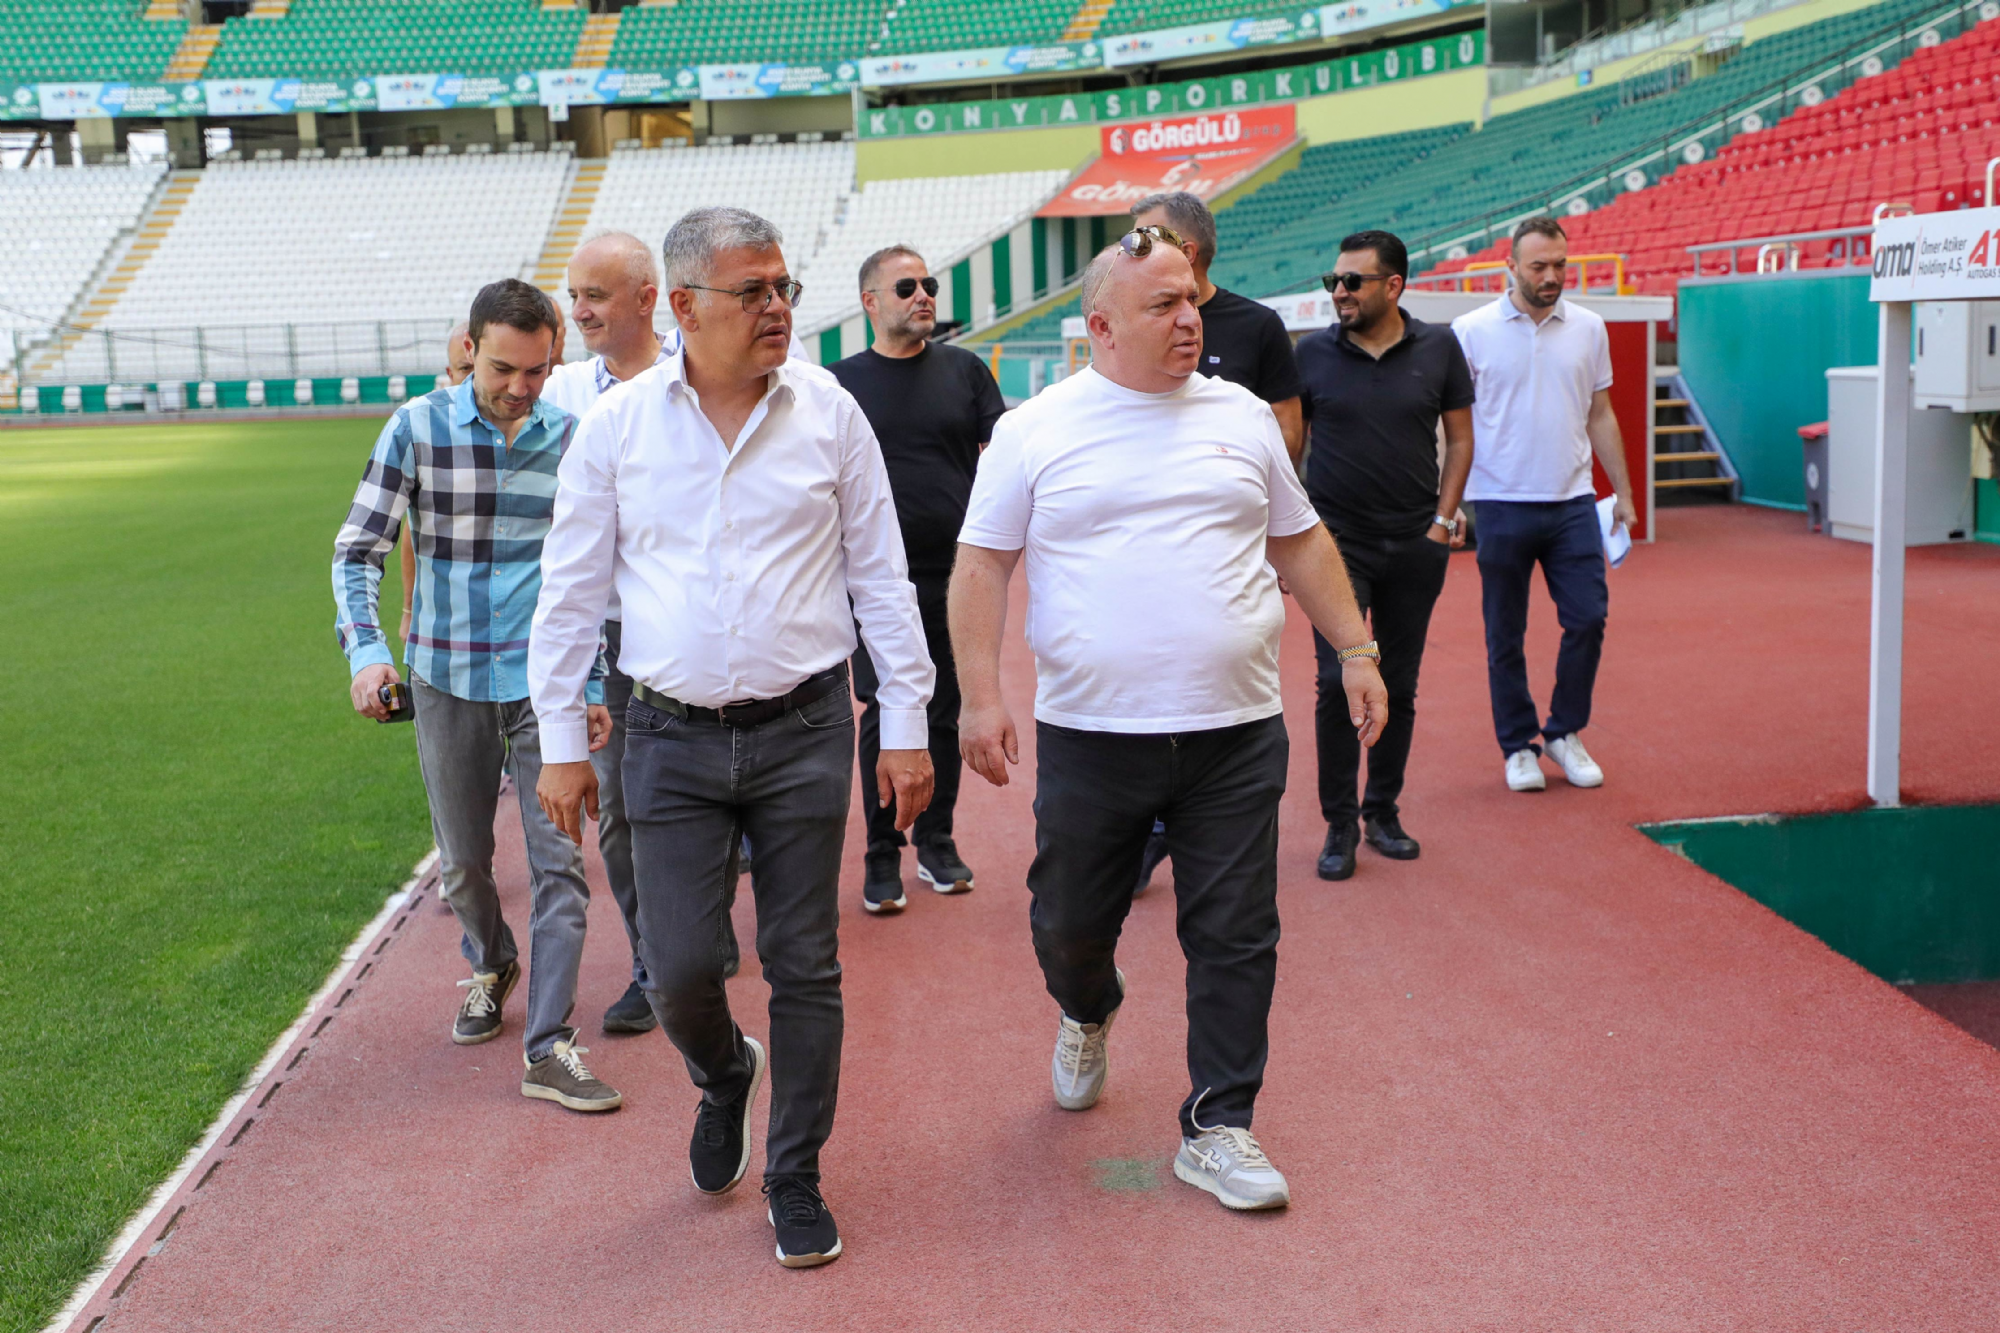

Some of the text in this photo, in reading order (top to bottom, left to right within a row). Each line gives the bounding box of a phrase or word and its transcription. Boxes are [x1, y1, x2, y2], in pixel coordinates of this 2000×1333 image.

[1132, 112, 1241, 152] GÖRGÜLÜ
[1921, 236, 1968, 255] Ömer Atiker
[1918, 258, 1947, 278] Holding
[1967, 268, 1997, 280] AUTOGAS
